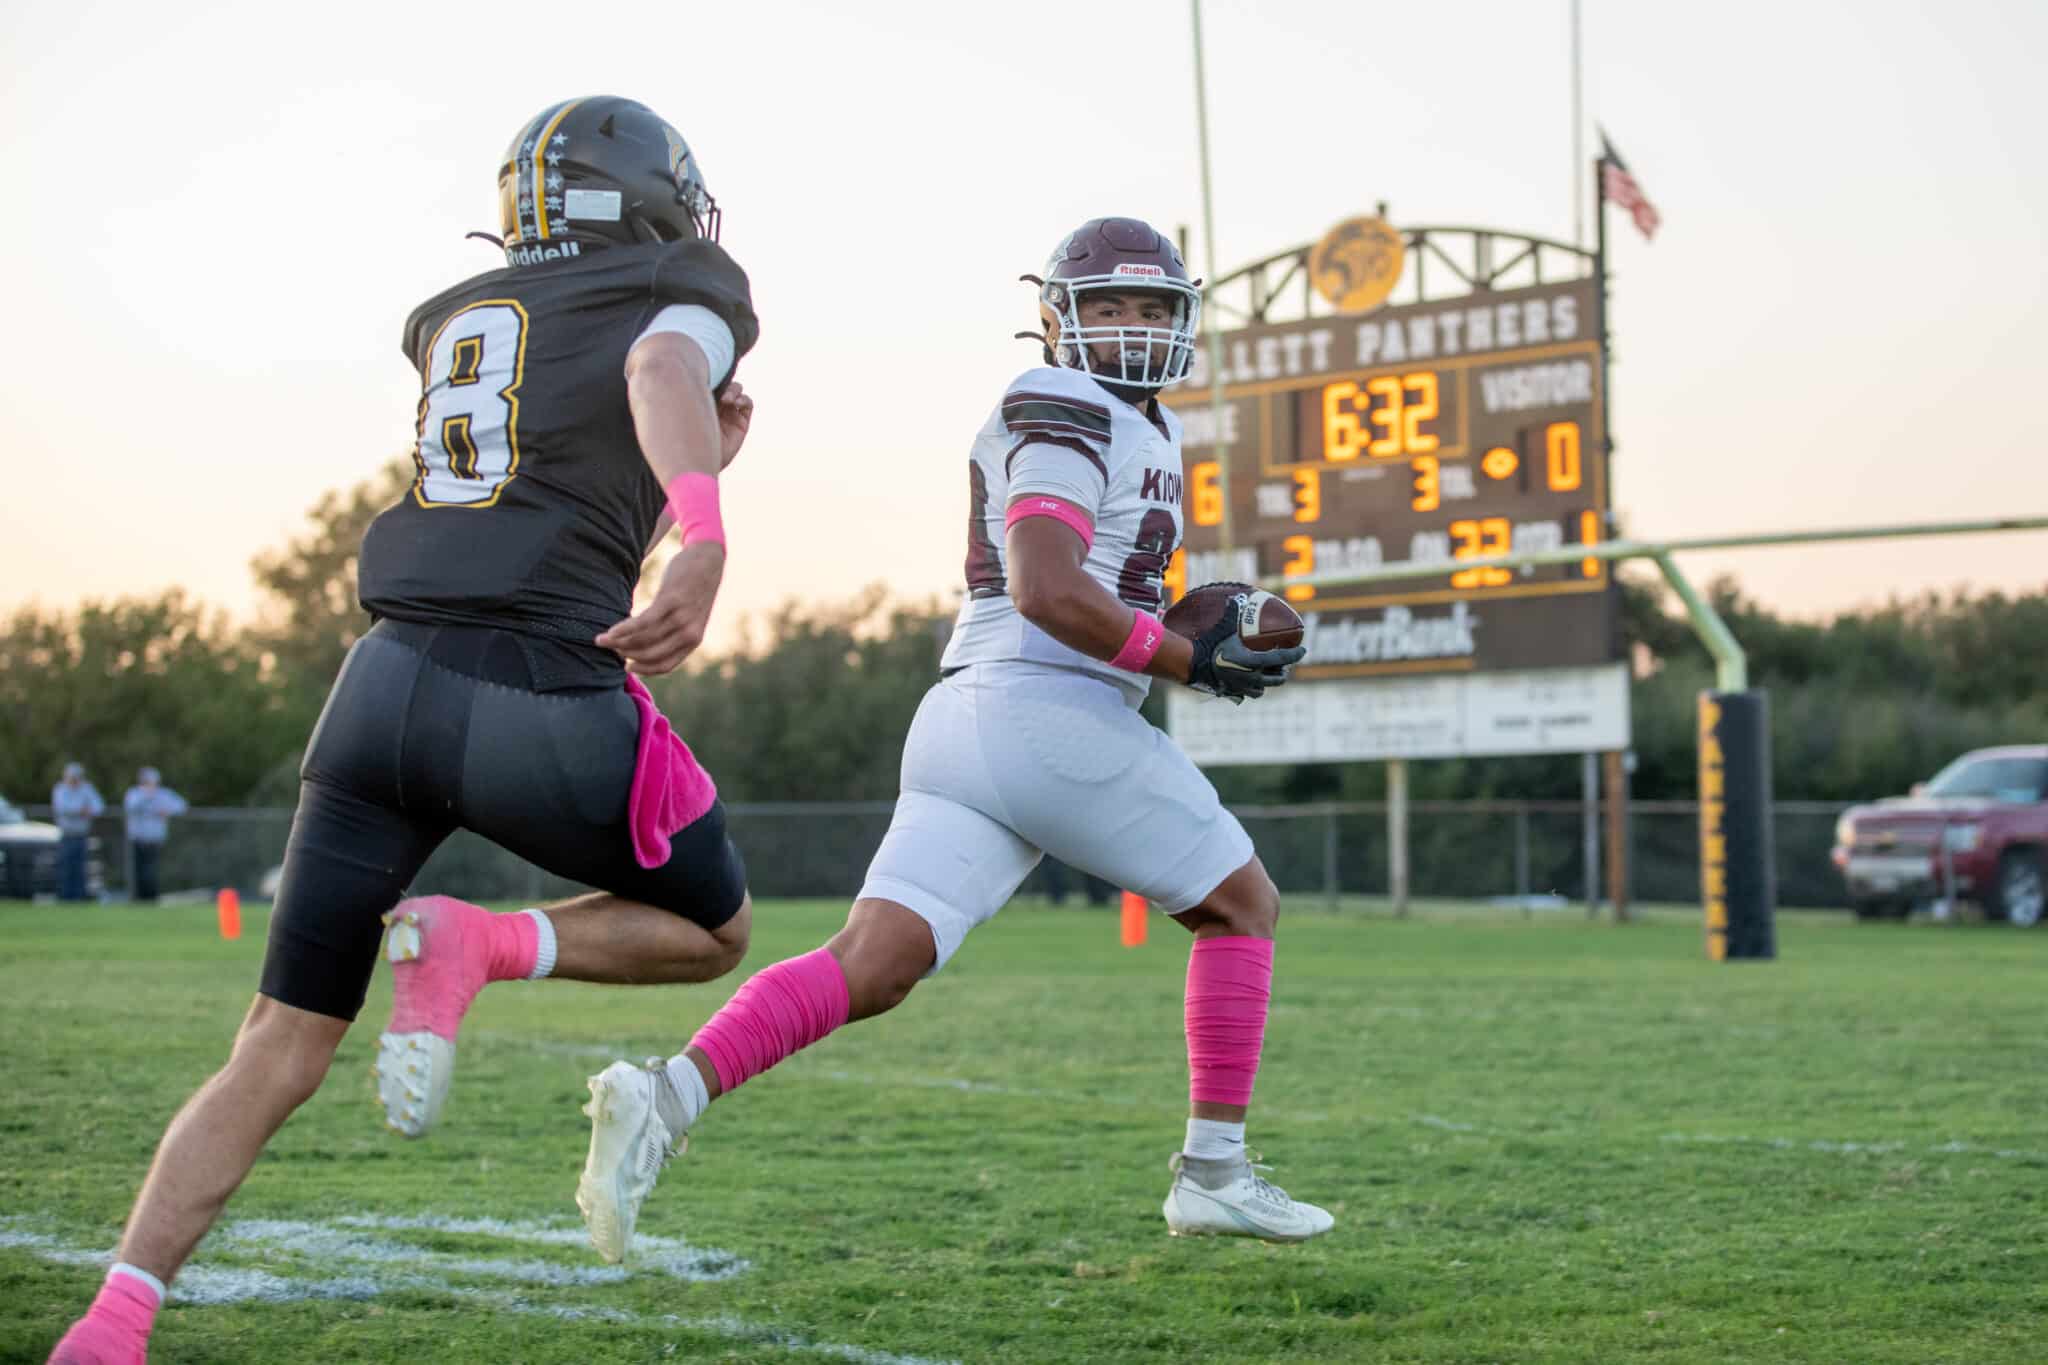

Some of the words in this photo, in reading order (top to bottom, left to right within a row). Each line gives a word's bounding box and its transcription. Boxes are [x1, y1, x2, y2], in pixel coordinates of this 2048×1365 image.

[506, 241, 580, 265] Riddell
[1120, 264, 1161, 276] Riddell
[1356, 295, 1578, 364] PANTHERS
[413, 298, 529, 509] 8
[1323, 371, 1440, 463] 6:32
[1140, 467, 1183, 504] KIOW
[1412, 454, 1440, 512] 3
[1547, 422, 1581, 491] 0
[1191, 461, 1224, 526] 6
[1293, 465, 1321, 523] 3
